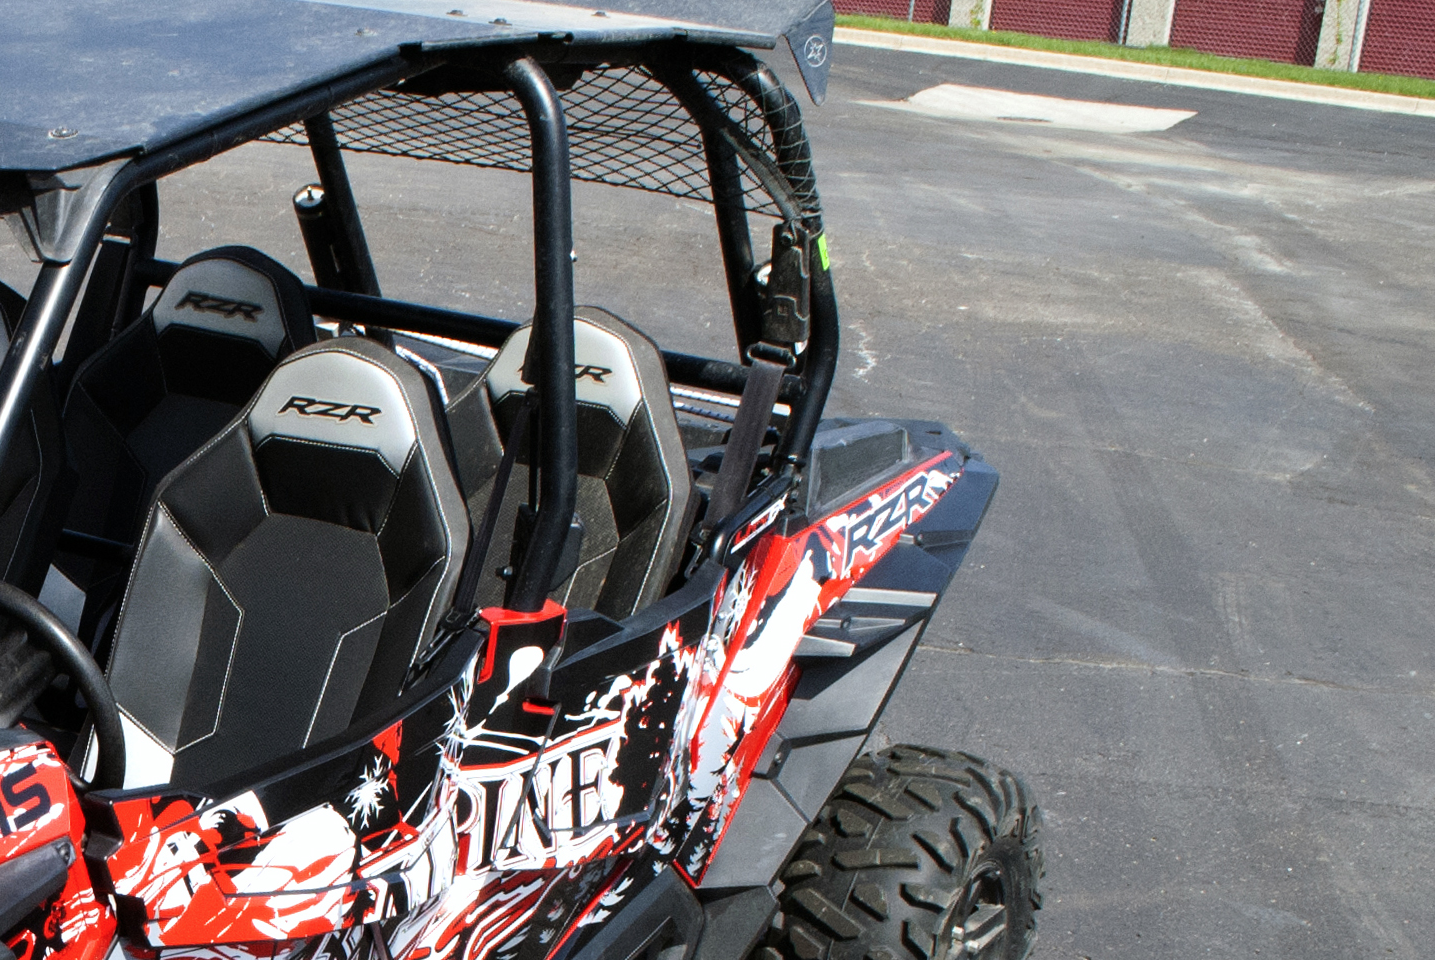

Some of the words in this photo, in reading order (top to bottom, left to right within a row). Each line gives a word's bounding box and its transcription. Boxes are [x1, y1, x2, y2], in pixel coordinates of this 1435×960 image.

[175, 290, 263, 322] RZR
[278, 396, 383, 425] RZR
[840, 471, 936, 581] RZR
